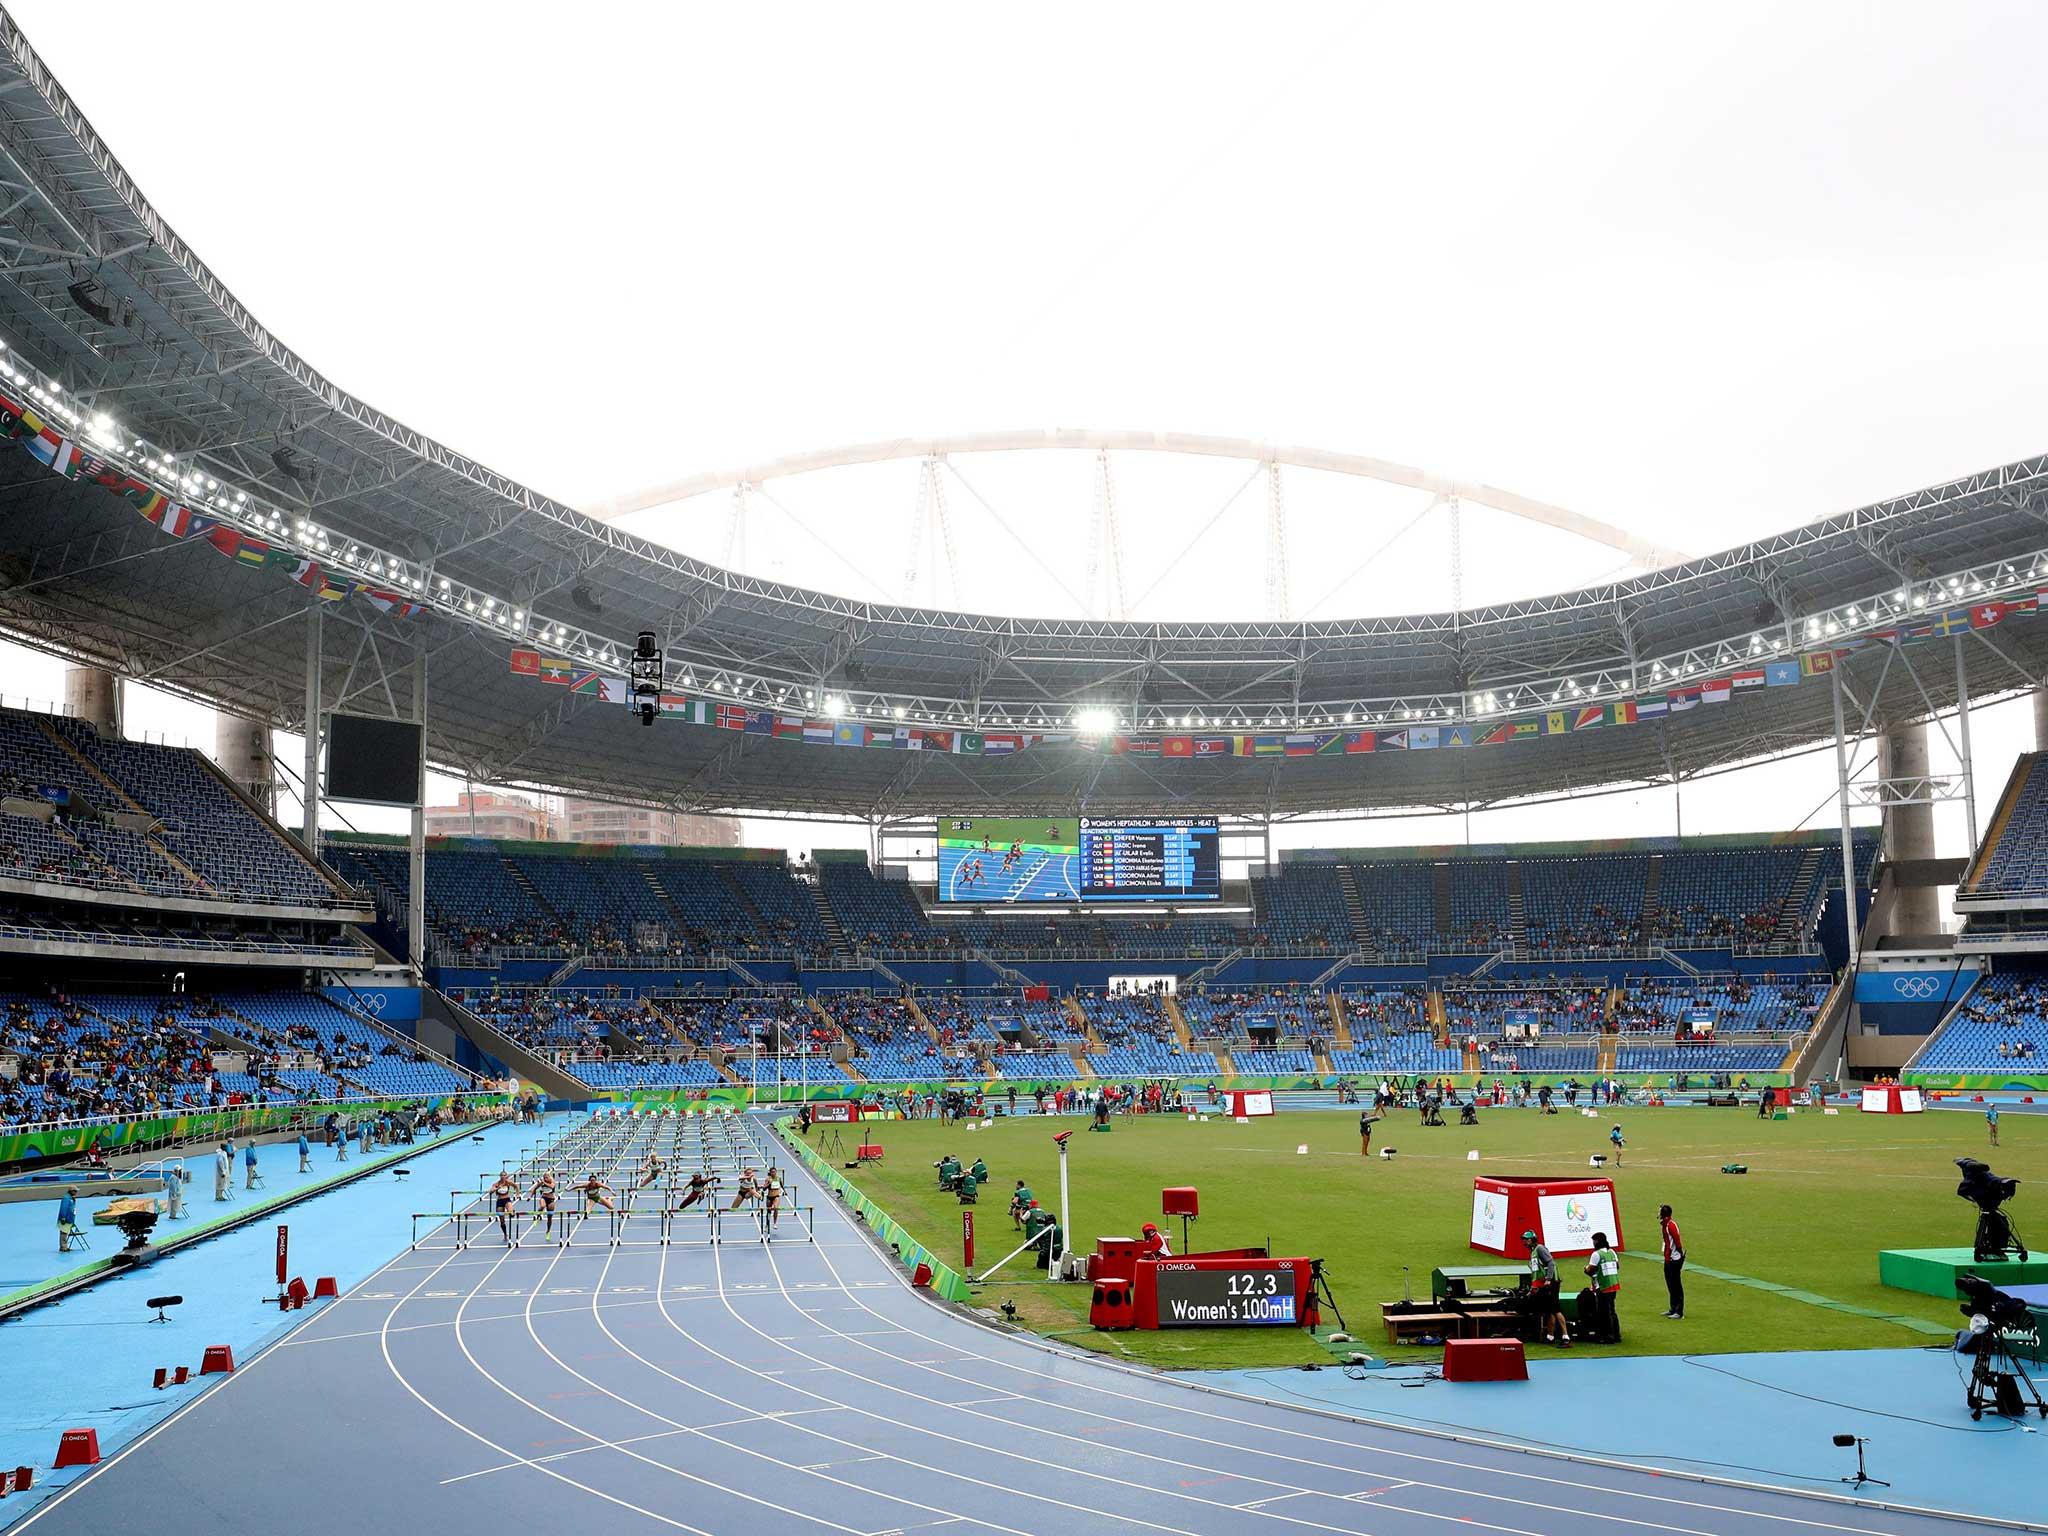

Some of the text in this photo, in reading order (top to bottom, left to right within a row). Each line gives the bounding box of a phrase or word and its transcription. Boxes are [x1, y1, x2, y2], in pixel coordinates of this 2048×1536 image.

[707, 1103, 735, 1111] Rio2016
[1567, 1224, 1591, 1233] Rio2016
[1166, 1263, 1196, 1271] OMEGA
[1228, 1274, 1277, 1295] 12.3
[1171, 1298, 1293, 1320] Women's 100mH
